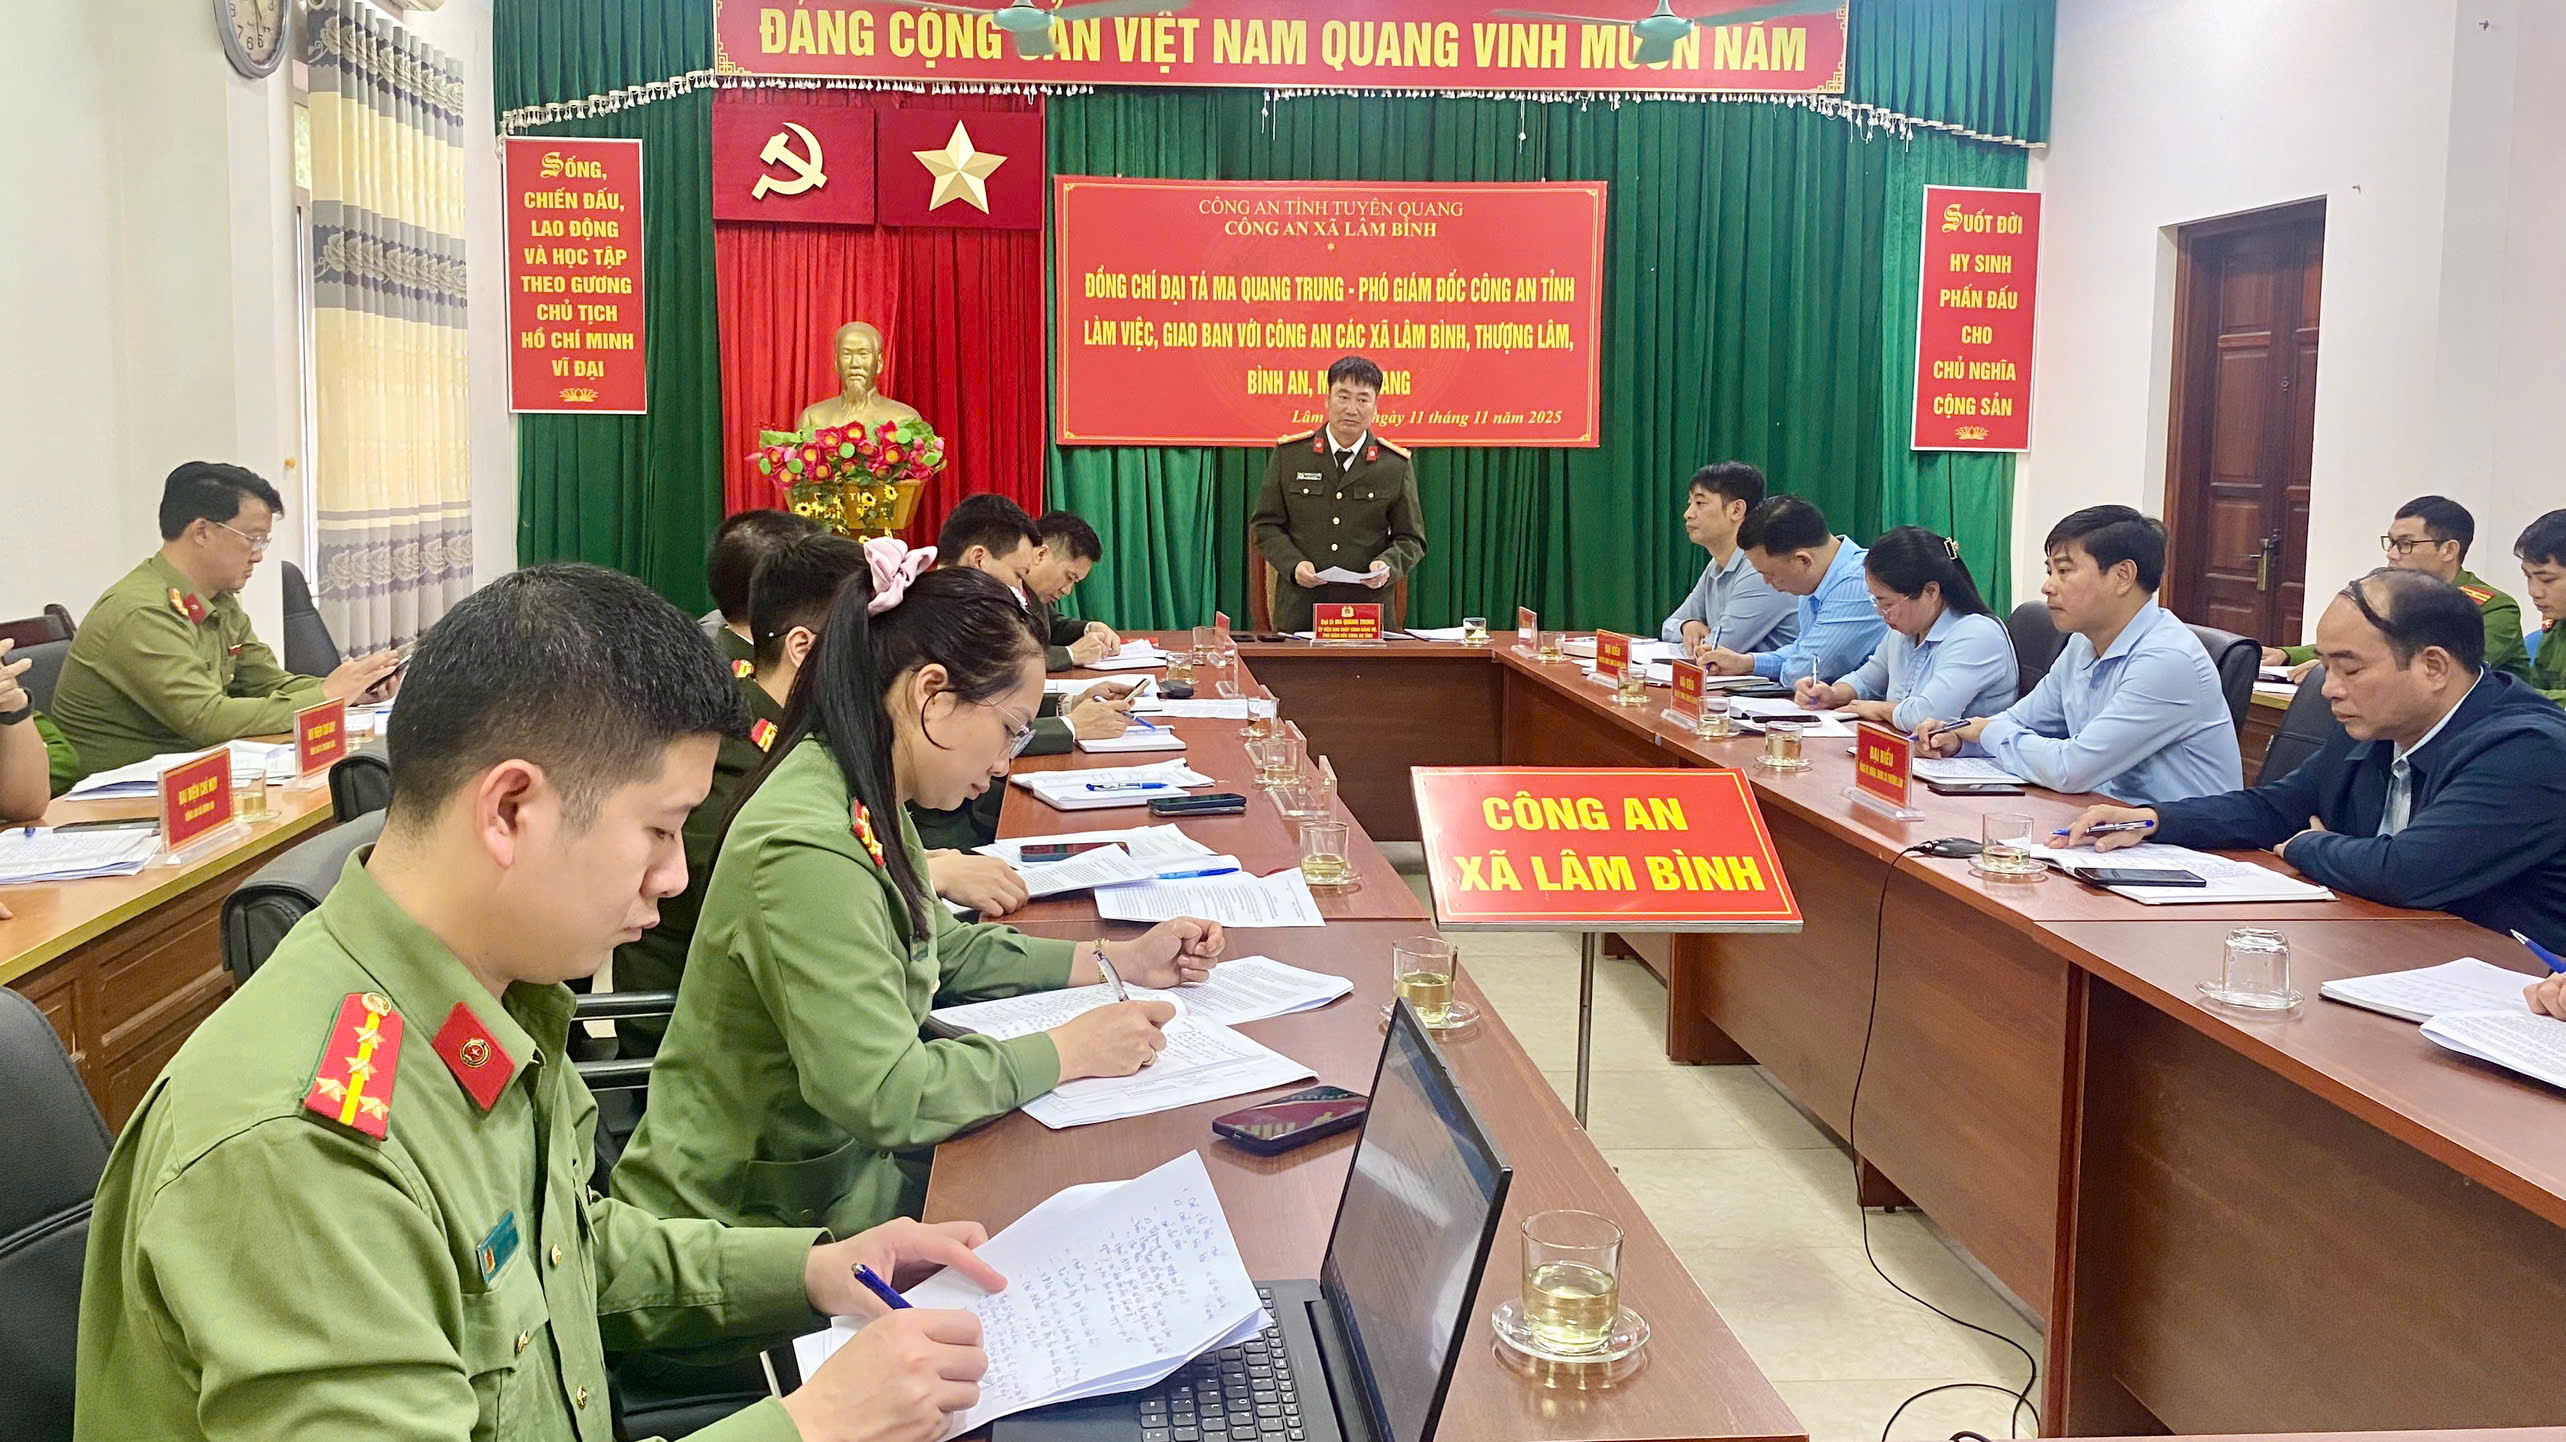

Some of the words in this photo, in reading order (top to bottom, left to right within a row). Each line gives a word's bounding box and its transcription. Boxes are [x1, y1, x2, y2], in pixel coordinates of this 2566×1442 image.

[889, 7, 1003, 69] CỘNG
[1018, 0, 1101, 62] ẢN
[1114, 11, 1200, 74] VIỆT
[1213, 18, 1307, 66] NAM
[1321, 20, 1459, 71] QUANG
[1472, 22, 1567, 69] VINH
[1580, 24, 1701, 71] MUN
[1713, 20, 1807, 73] NĂM
[540, 151, 608, 180] SỐNG,
[523, 186, 579, 209] CHIẾN
[583, 187, 625, 212] ĐẤU,
[1198, 196, 1251, 215] CÔNG
[1254, 200, 1281, 215] AN
[1332, 197, 1394, 216] TUYÊN
[1397, 201, 1465, 219] QUANG
[531, 220, 565, 238] LAO
[569, 217, 619, 241] ĐỘNG
[1224, 216, 1280, 236] CÔNG
[1283, 221, 1310, 236] AN
[1313, 218, 1340, 236] XÃ
[1344, 218, 1386, 237] LÂM
[1390, 218, 1438, 237] BÌNH
[1942, 204, 1993, 233] SUỐT
[1997, 212, 2023, 235] ĐỜI
[523, 244, 548, 266] VÀ
[552, 248, 589, 269] HỌC
[593, 246, 628, 270] TẬP
[1950, 253, 1971, 273] HY
[1974, 254, 2012, 274] SINH
[520, 276, 566, 294] THEO
[570, 275, 633, 295] GƯƠNG
[1131, 269, 1157, 300] CHÍ
[1160, 275, 1187, 305] ĐẠI
[1189, 270, 1209, 301] TÁ
[1212, 275, 1238, 301] MA
[1241, 276, 1292, 304] QUANG
[1295, 276, 1344, 303] TRUNG
[1358, 272, 1390, 302] PHÓ
[1393, 272, 1432, 303] GIÁM
[1436, 269, 1466, 303] ĐỐC
[1470, 272, 1512, 303] CÔNG
[1515, 277, 1537, 303] AN
[1541, 269, 1576, 303] TỈNH
[1939, 284, 1983, 308] PHẤN
[1987, 286, 2018, 310] ĐẤU
[536, 298, 572, 321] CHỦ
[577, 303, 618, 325] TỊCH
[521, 326, 545, 349] HỒ
[550, 329, 582, 349] CHÍ
[586, 332, 635, 350] MINH
[1084, 315, 1117, 346] LÀM
[1120, 316, 1159, 352] VIỆC,
[1162, 321, 1198, 348] GIAO
[1202, 322, 1233, 348] BAN
[1237, 318, 1262, 348] VỚI
[1265, 318, 1307, 349] CÔNG
[1310, 323, 1332, 349] AN
[1335, 319, 1366, 350] CÁC
[1369, 320, 1391, 350] XÃ
[1394, 319, 1427, 350] LÂM
[1430, 320, 1471, 353] BÌNH,
[1475, 323, 1534, 355] THƯỢNG
[1538, 319, 1575, 353] LÂM,
[1961, 325, 1993, 345] CHO
[551, 356, 570, 378] VĨ
[573, 359, 605, 381] ĐẠI
[1247, 364, 1283, 395] BÌNH
[1287, 370, 1313, 398] AN,
[1933, 356, 1965, 380] CHỦ
[1968, 359, 2016, 381] NGHĨA
[1291, 410, 1324, 424] Lâm
[1371, 411, 1405, 427] ngày
[1409, 411, 1424, 425] 11
[1428, 411, 1470, 427] tháng
[1473, 411, 1489, 425] 11
[1493, 412, 1524, 425] năm
[1528, 411, 1563, 425] 2025
[1933, 393, 1977, 419] CỘNG
[1980, 392, 2012, 417] SẢN
[1482, 791, 1610, 831] CÔNG
[1624, 797, 1689, 831] AN
[1454, 850, 1522, 891] XÃ
[1530, 849, 1637, 891] LÂM
[1644, 849, 1766, 891] BÌNH
